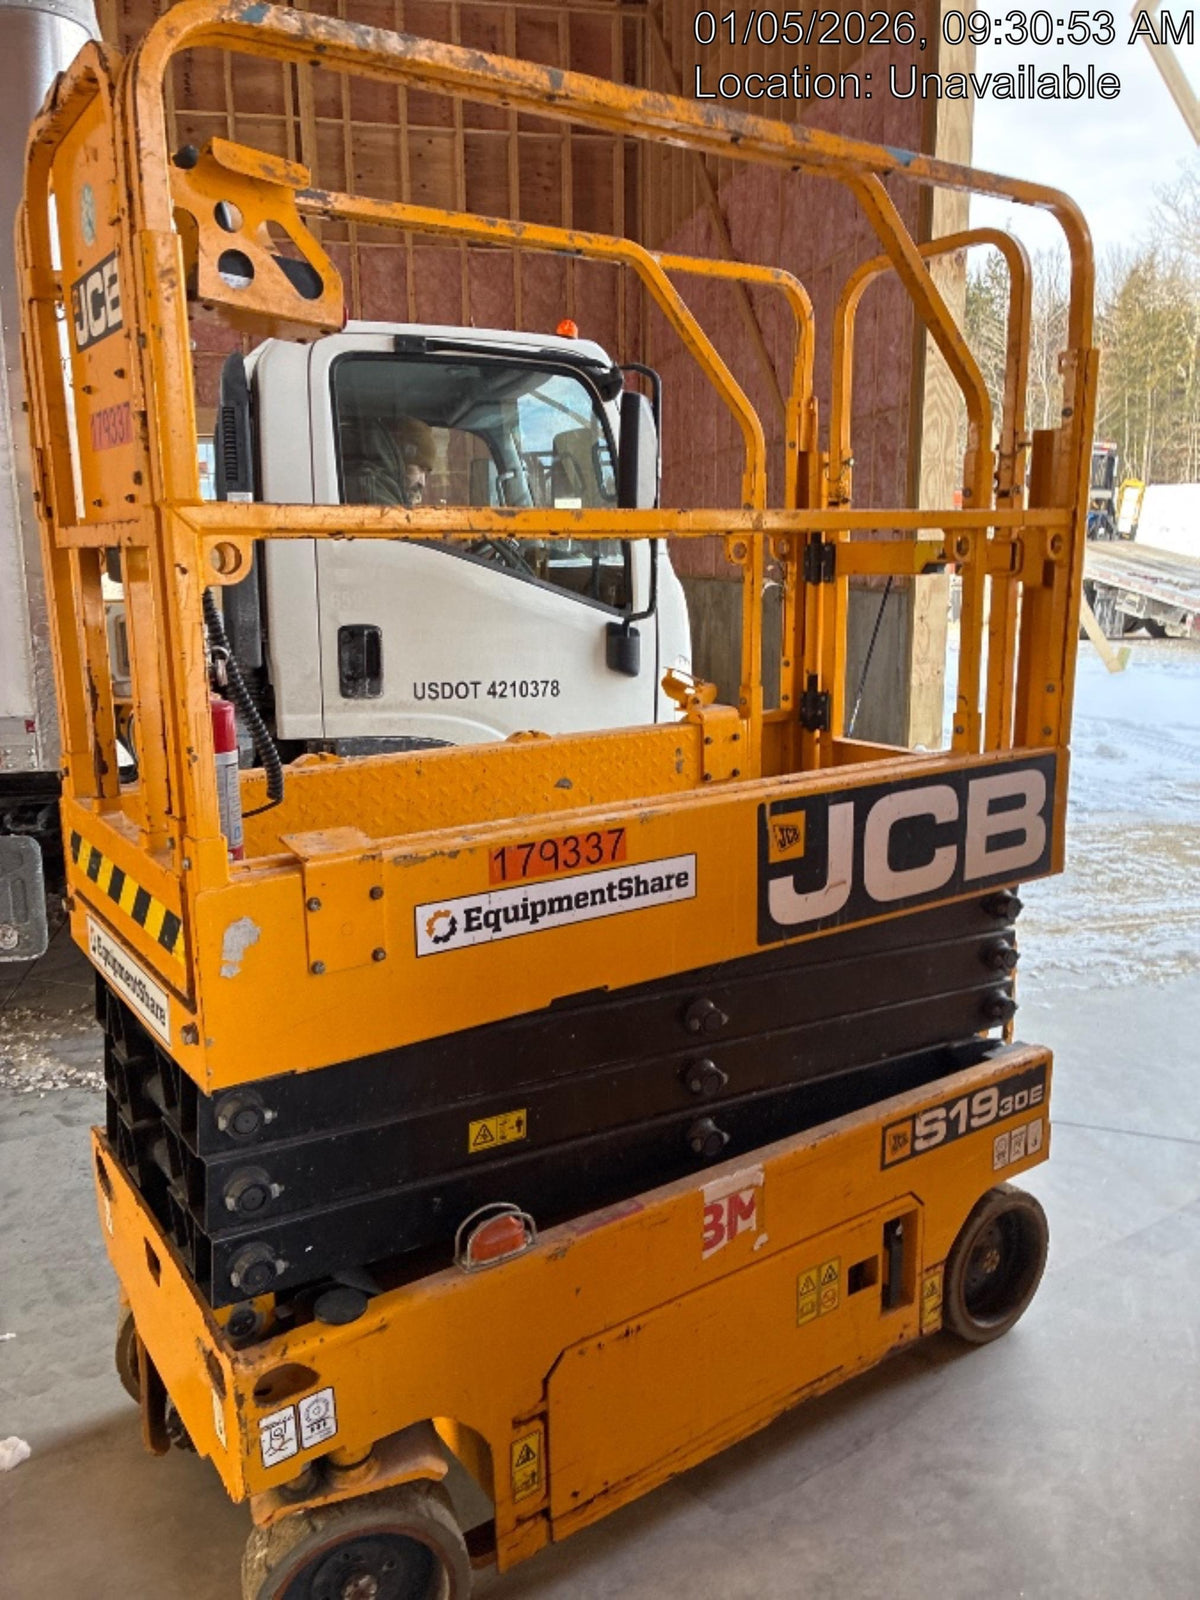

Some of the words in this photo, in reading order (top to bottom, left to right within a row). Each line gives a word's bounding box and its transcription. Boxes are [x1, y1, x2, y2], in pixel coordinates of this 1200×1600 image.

[91, 402, 131, 446] 179337
[413, 681, 482, 700] USDOT
[486, 679, 561, 699] 4210378
[493, 828, 625, 881] 179337
[768, 768, 1047, 926] JCB
[463, 871, 689, 933] EquipmentShare
[96, 932, 167, 1027] EquipmentShare
